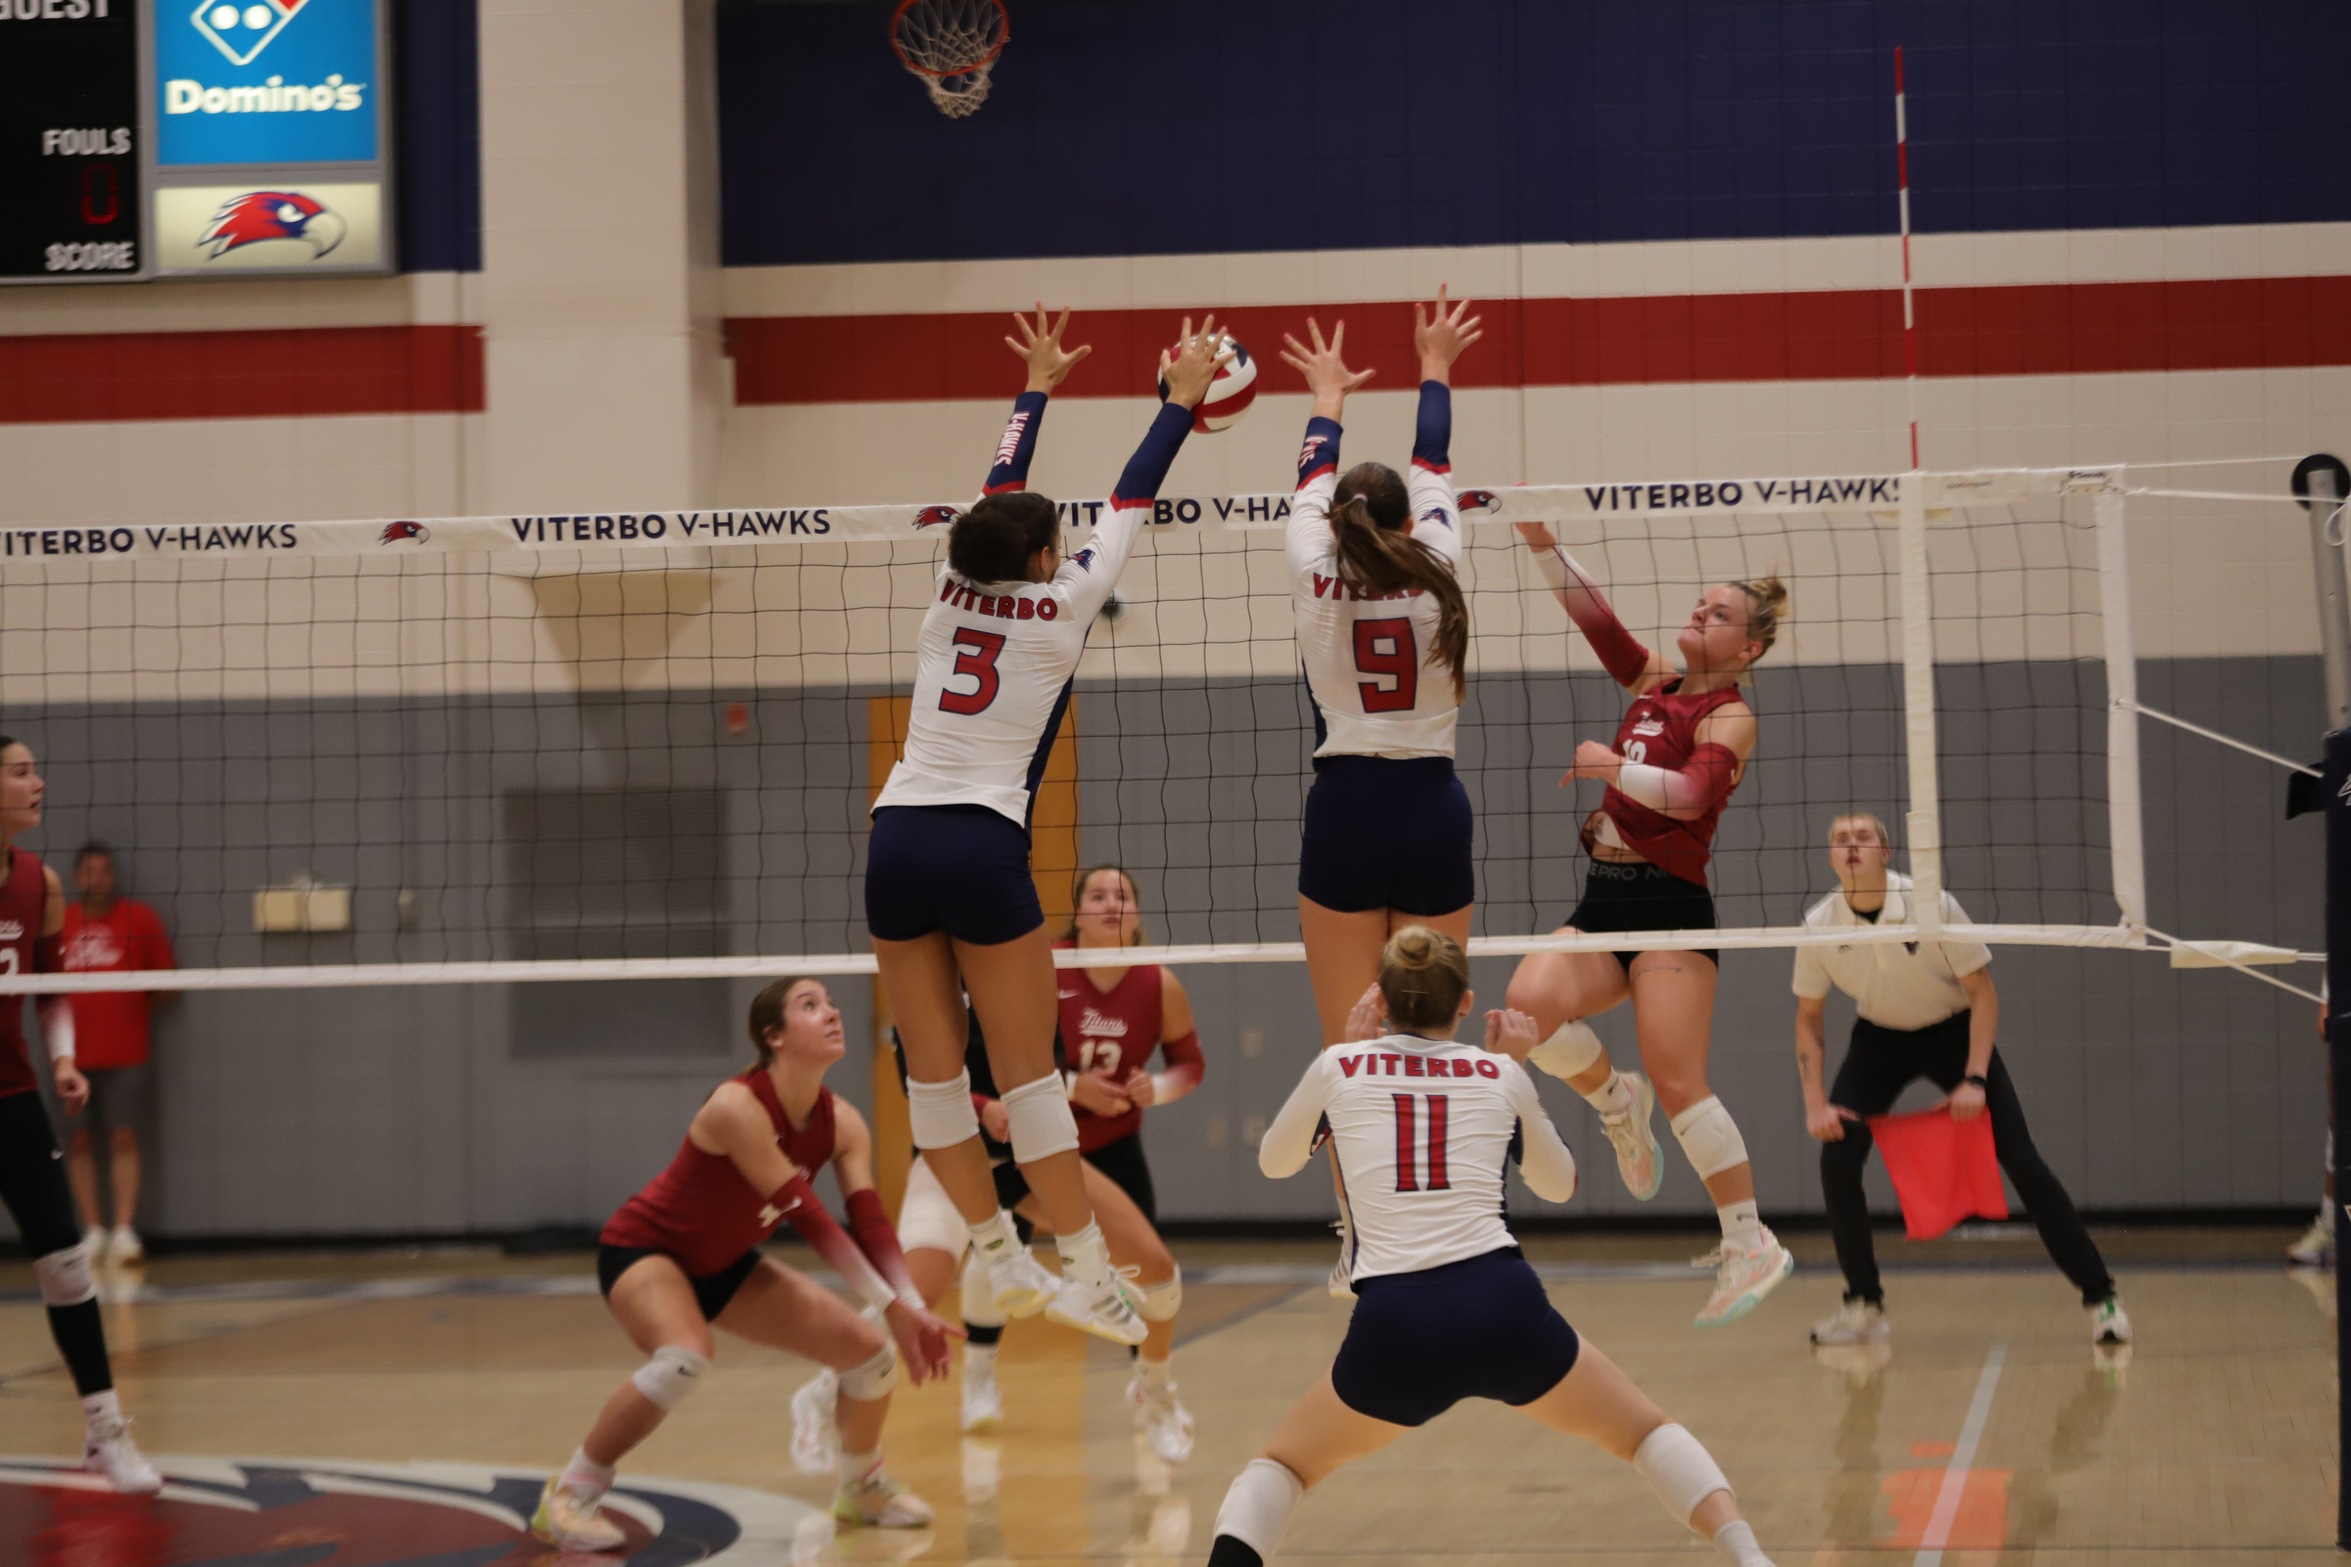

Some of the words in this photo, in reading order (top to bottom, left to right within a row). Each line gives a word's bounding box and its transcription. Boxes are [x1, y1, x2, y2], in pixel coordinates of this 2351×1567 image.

[165, 74, 367, 115] Domino's
[43, 128, 131, 156] FOULS
[45, 242, 135, 271] SCORE
[1584, 481, 1744, 511] VITERBO
[0, 527, 135, 556] ITERBO
[145, 523, 297, 550] V-HAWKS
[511, 513, 667, 543] VITERBO
[677, 508, 831, 538] V-HAWKS
[940, 577, 1058, 622] VITERBO
[937, 625, 1007, 716] 3
[1353, 616, 1418, 714] 9
[1337, 1053, 1500, 1080] VITERBO
[1391, 1093, 1451, 1192] 11
